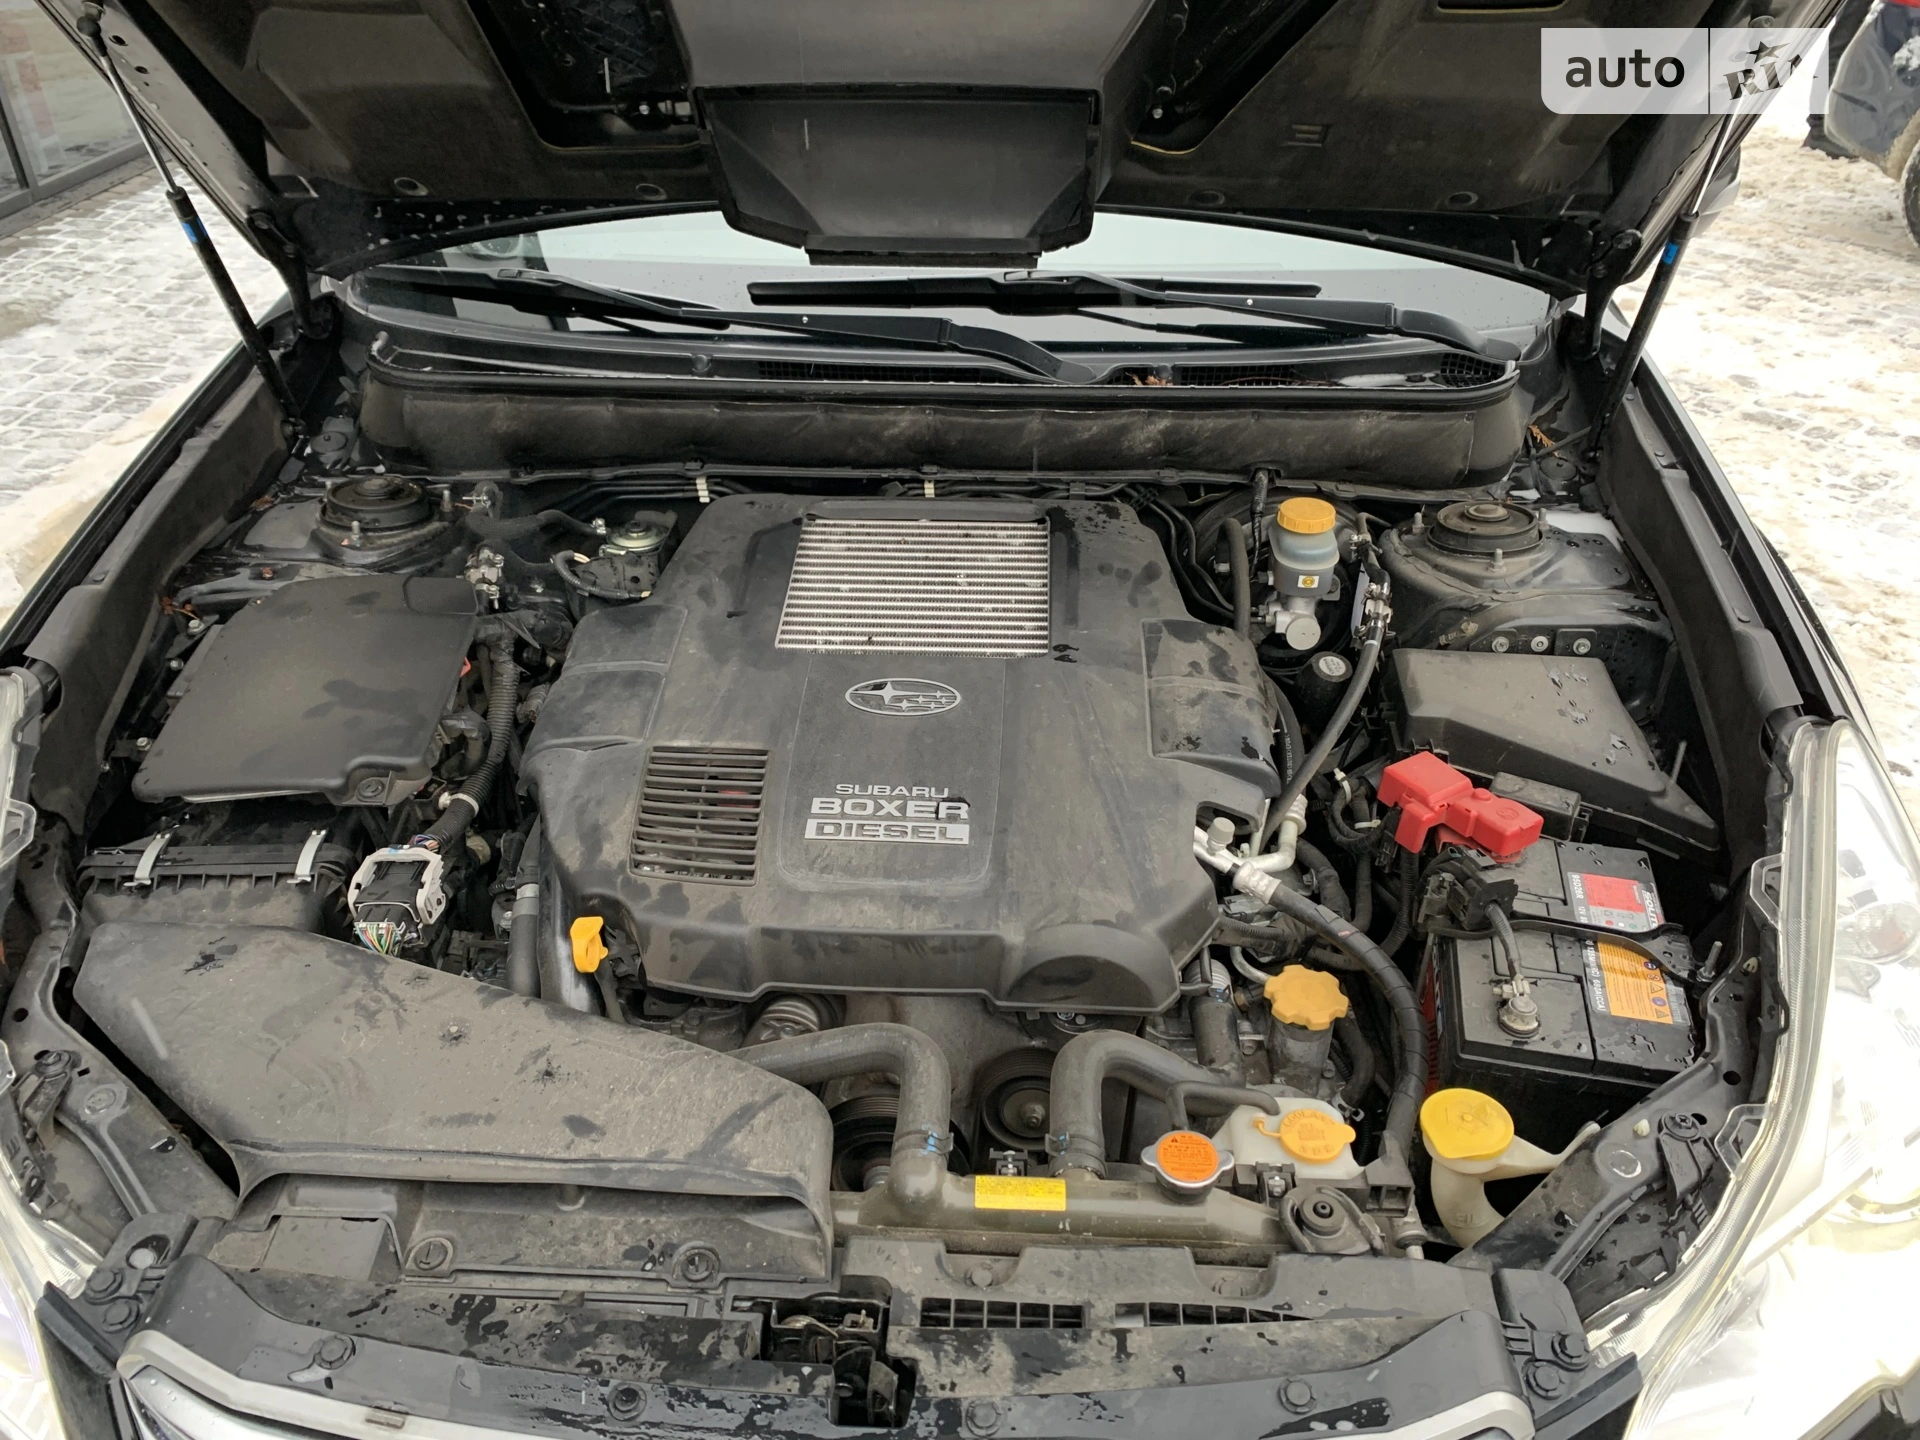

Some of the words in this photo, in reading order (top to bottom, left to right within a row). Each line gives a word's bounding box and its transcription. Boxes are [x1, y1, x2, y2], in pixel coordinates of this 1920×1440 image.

[835, 783, 949, 798] SUBARU
[810, 797, 969, 820] BOXER
[814, 821, 965, 842] DIESEL
